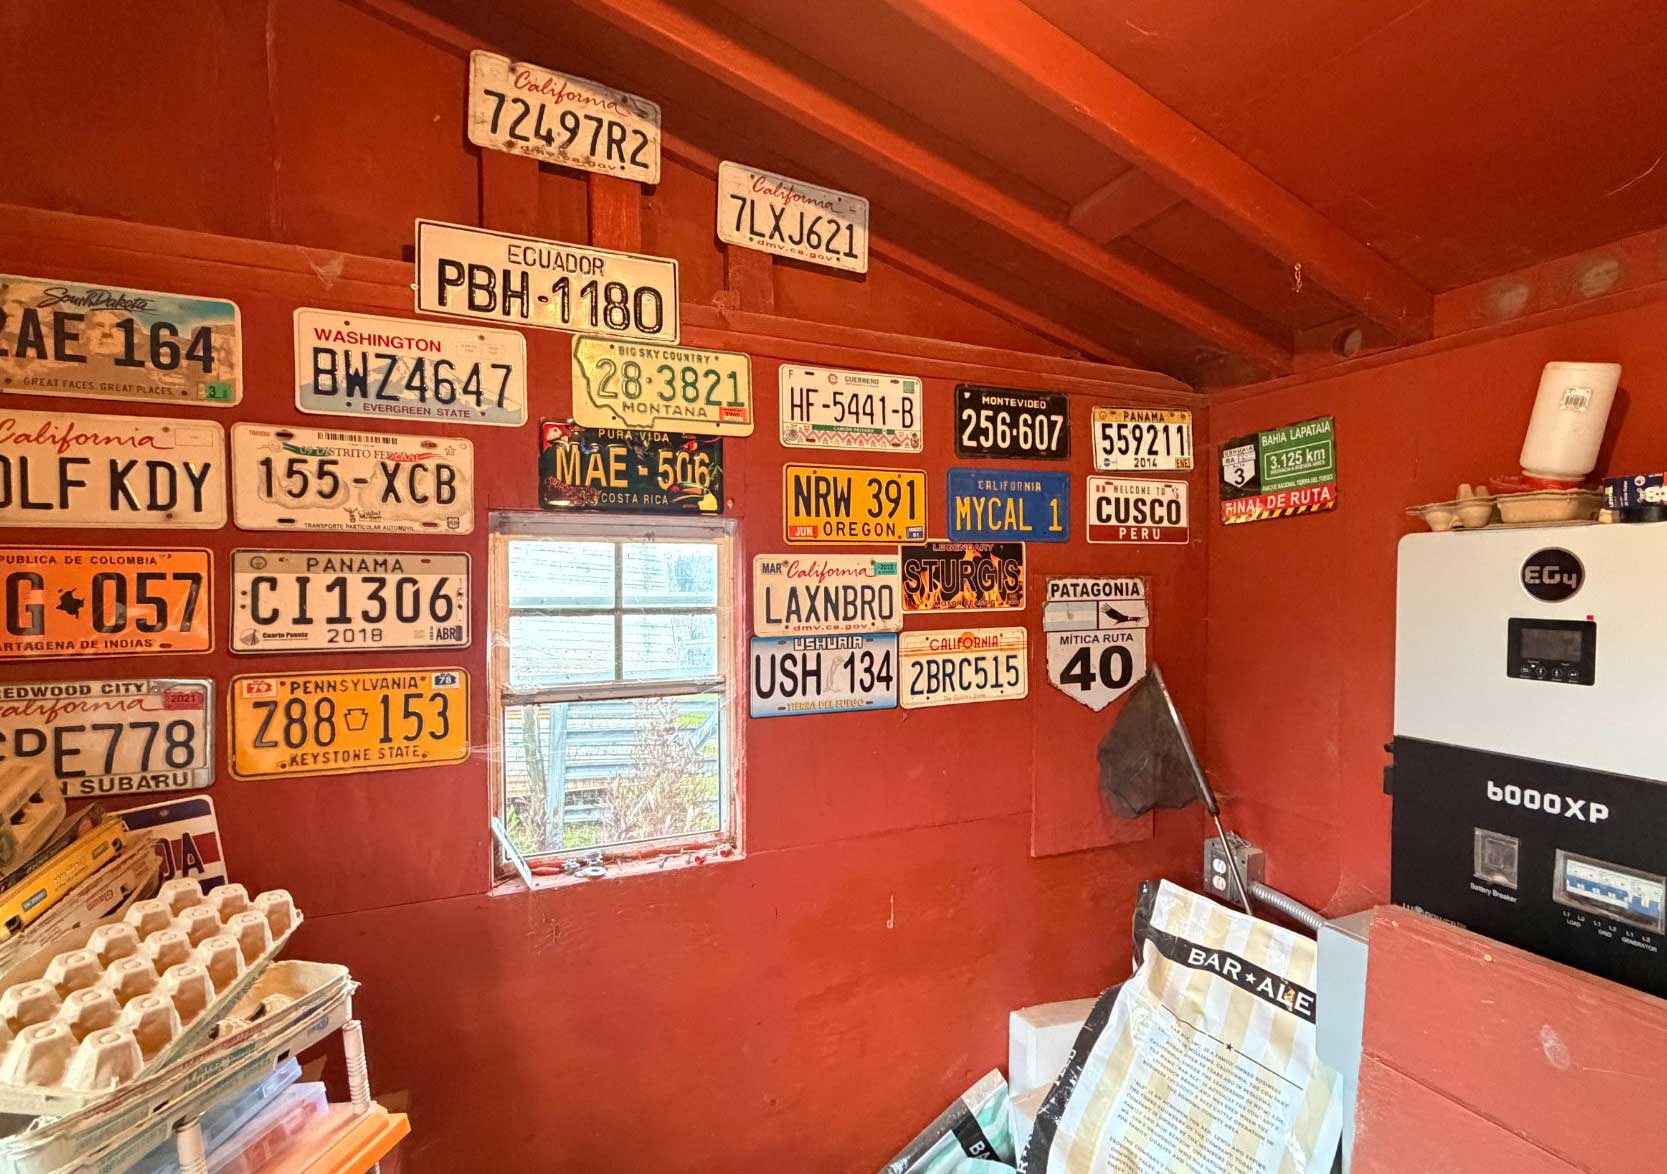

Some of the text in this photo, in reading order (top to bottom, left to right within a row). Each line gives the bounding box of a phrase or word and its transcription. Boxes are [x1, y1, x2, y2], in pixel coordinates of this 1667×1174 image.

[513, 71, 628, 117] California
[484, 89, 649, 169] 72497R2
[752, 177, 842, 214] California
[730, 194, 858, 260] 7LXJ621
[507, 244, 605, 277] ECUADOR
[757, 240, 832, 262] dmv.ca.gov
[91, 289, 150, 312] Dakota
[437, 258, 664, 334] PBH-1180
[114, 317, 215, 373] 164
[314, 327, 442, 352] WASHINGTON
[618, 346, 711, 364] BIG SKY COUNTRY
[23, 376, 59, 388] GREAT
[100, 382, 133, 394] GREAT
[312, 347, 512, 409] BWZ4647
[844, 375, 880, 385] GUERRERO
[208, 385, 217, 398] 3
[363, 403, 470, 418] EVERGREEN STATE
[622, 402, 708, 418] MONTANA
[790, 386, 914, 429] HF-5441-B
[981, 396, 1046, 409] MONTEVIDEO
[1123, 411, 1165, 423] PANAMA
[0, 418, 174, 454] California
[598, 429, 670, 443] PURA VIDA
[1290, 420, 1331, 440] LAPATAIA
[1101, 423, 1185, 457] 559211
[316, 446, 371, 460] DISTRITO
[374, 450, 420, 462] FEDERAL
[1134, 457, 1158, 468] 2014
[1270, 448, 1326, 470] 3.125 km
[109, 459, 211, 512] KDY
[978, 480, 1041, 492] CALIFORNIA
[1234, 467, 1245, 486] 3
[601, 492, 669, 505] COSTA RICA
[793, 474, 915, 520] NRW 391
[1113, 485, 1165, 496] WELCOME TO
[1225, 486, 1331, 515] FINAL DE RUTA
[955, 496, 1062, 531] MYCAL 1
[1096, 496, 1181, 525] CUSCO
[304, 522, 343, 530] TRANSPORTE
[345, 523, 382, 531] PARTICULAR
[794, 526, 813, 537] JUN
[823, 521, 896, 537] OREGON
[1119, 528, 1160, 540] PERU
[64, 555, 81, 565] DE
[90, 556, 157, 565] COLOMBIA
[306, 557, 404, 573] PANAMA
[762, 562, 782, 574] MAR
[786, 560, 876, 584] California
[903, 558, 1020, 595] STURGIS
[1051, 582, 1140, 598] PATAGONIA
[6, 572, 203, 636] G 057
[765, 584, 894, 624] LAXNBRO
[327, 628, 383, 643] 2018
[436, 627, 456, 641] ABR
[793, 624, 867, 632] dmv.ca.gov
[80, 640, 98, 649] DE
[104, 639, 152, 649] INDIAS
[793, 636, 864, 651] USHUAIA
[930, 635, 999, 651] CALIFORNIA
[1060, 633, 1134, 645] MÍTICA RUTA
[755, 650, 893, 699] USH 134
[910, 655, 1019, 696] 2BRC515
[1060, 645, 1133, 691] 40
[250, 684, 268, 693] 79
[290, 676, 418, 694] PENNSYLVANIA
[439, 675, 452, 685] 78
[0, 682, 145, 699] EDWOOD CITY
[171, 694, 196, 704] 2021
[0, 698, 164, 724] alifornia
[786, 699, 864, 712] TIERRA DEL FUEGO
[252, 693, 450, 748] Z88 153
[289, 745, 419, 767] KEYSTONE STATE
[81, 772, 188, 795] SUBARU
[1487, 780, 1609, 823] 6000XP
[1470, 882, 1518, 903] Battery Breaker
[1566, 918, 1582, 928] LOAD
[1621, 937, 1658, 953] GENERATOR
[1188, 947, 1315, 1016] BAR ALE
